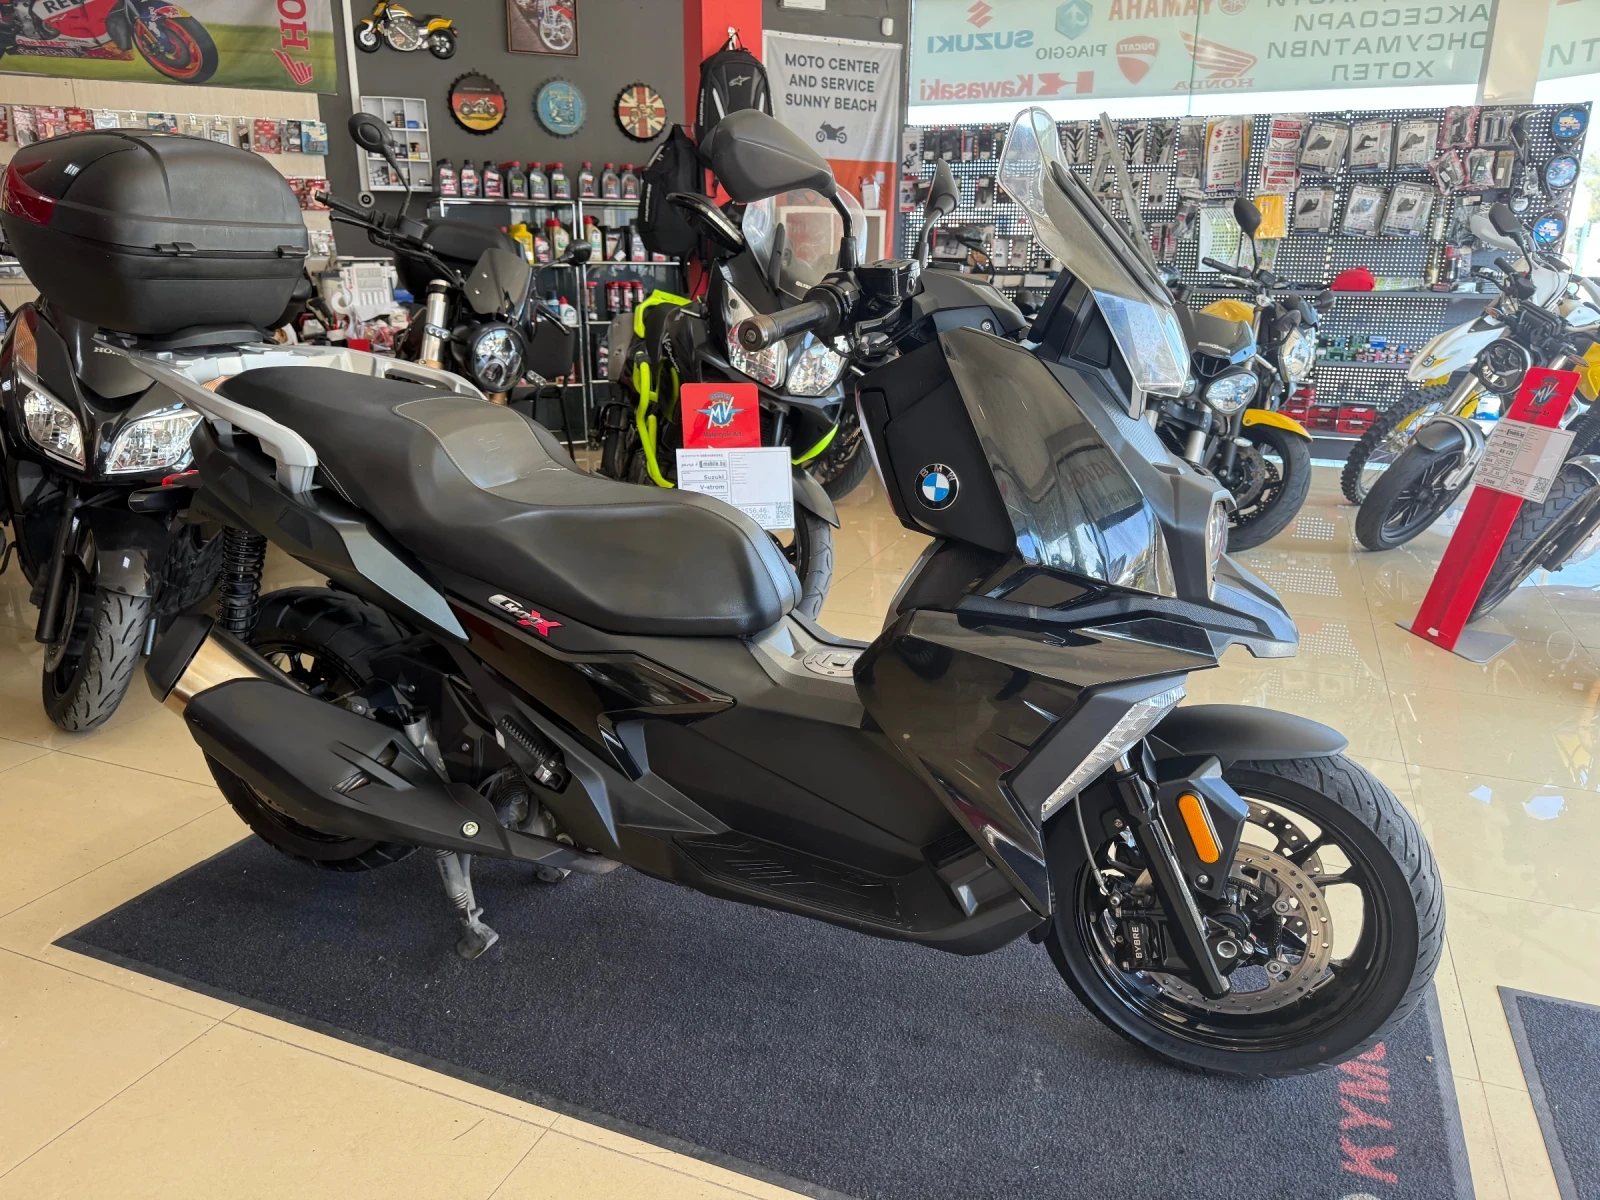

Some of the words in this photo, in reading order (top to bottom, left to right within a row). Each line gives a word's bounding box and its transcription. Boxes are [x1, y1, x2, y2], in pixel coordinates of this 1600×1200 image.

[785, 53, 825, 69] MOTO
[828, 58, 880, 74] CENTER
[789, 74, 817, 89] AND
[821, 77, 875, 93] SERVICE
[785, 93, 831, 108] SUNNY
[834, 97, 877, 112] BEACH
[920, 464, 957, 482] BMW
[1509, 476, 1525, 486] 3500
[1131, 926, 1143, 959] BYBRE
